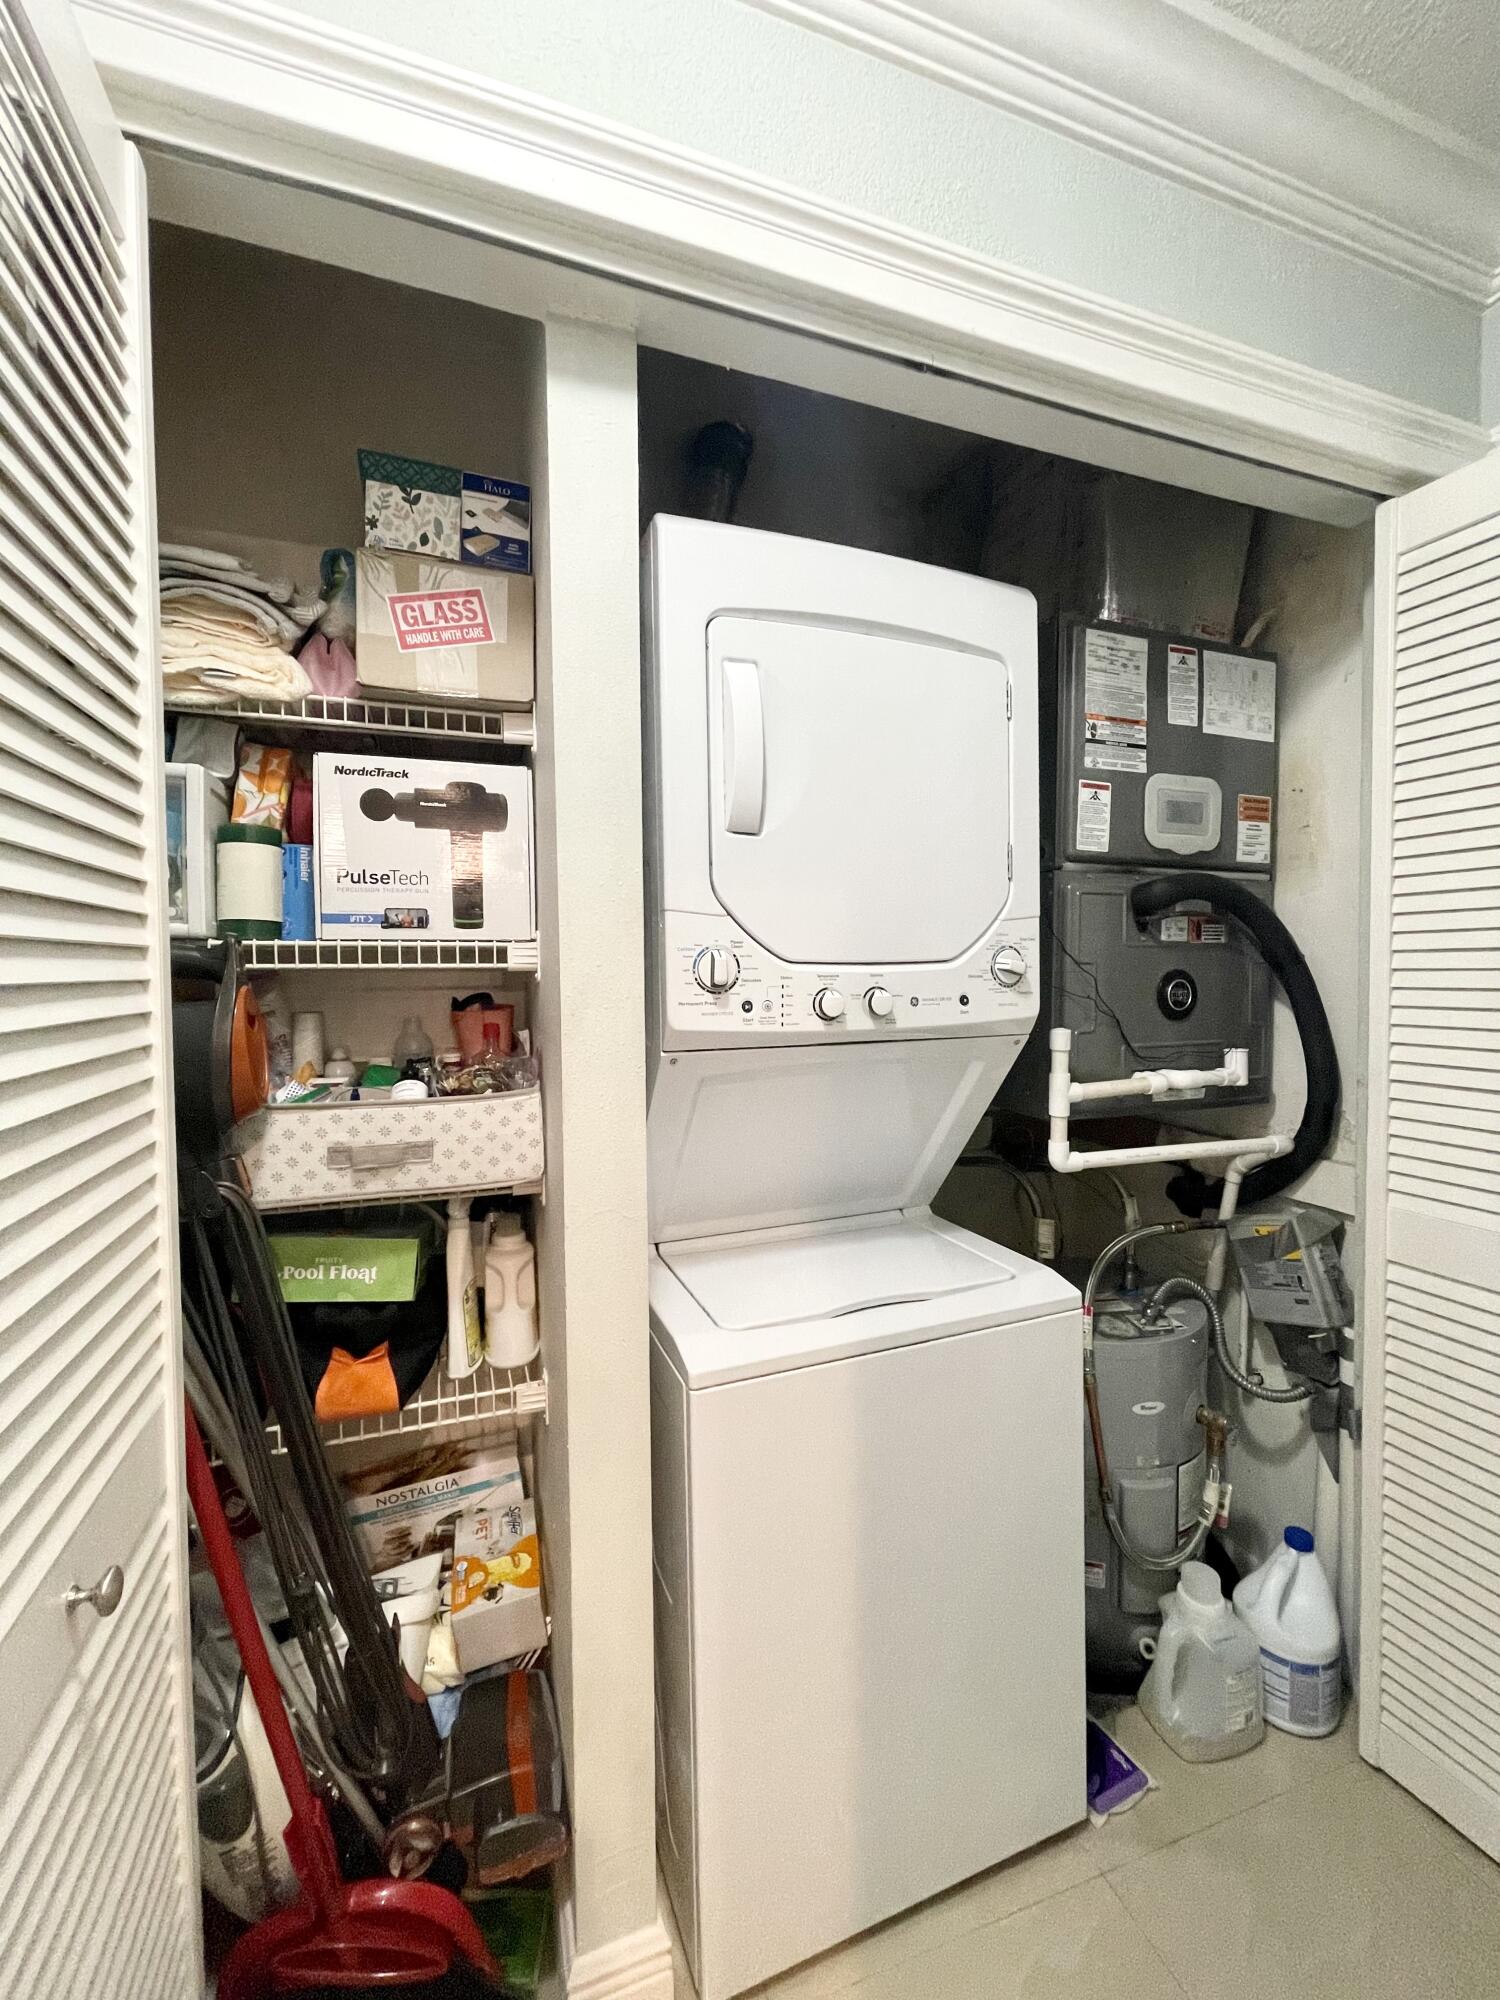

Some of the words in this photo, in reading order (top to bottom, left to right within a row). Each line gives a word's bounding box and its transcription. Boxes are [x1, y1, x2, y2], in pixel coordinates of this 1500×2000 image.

[484, 483, 511, 496] HALO
[401, 599, 479, 628] GLASS
[405, 631, 440, 646] HANDLE
[440, 629, 463, 642] WITH
[463, 626, 486, 640] CARE
[334, 765, 409, 779] NordicTrack
[301, 847, 311, 883] Inhaler
[336, 869, 430, 886] PulseTech
[382, 886, 414, 894] THERAPY
[280, 1264, 324, 1280] Pool
[329, 1264, 378, 1285] Float
[375, 1478, 460, 1508] NOSTALGIA
